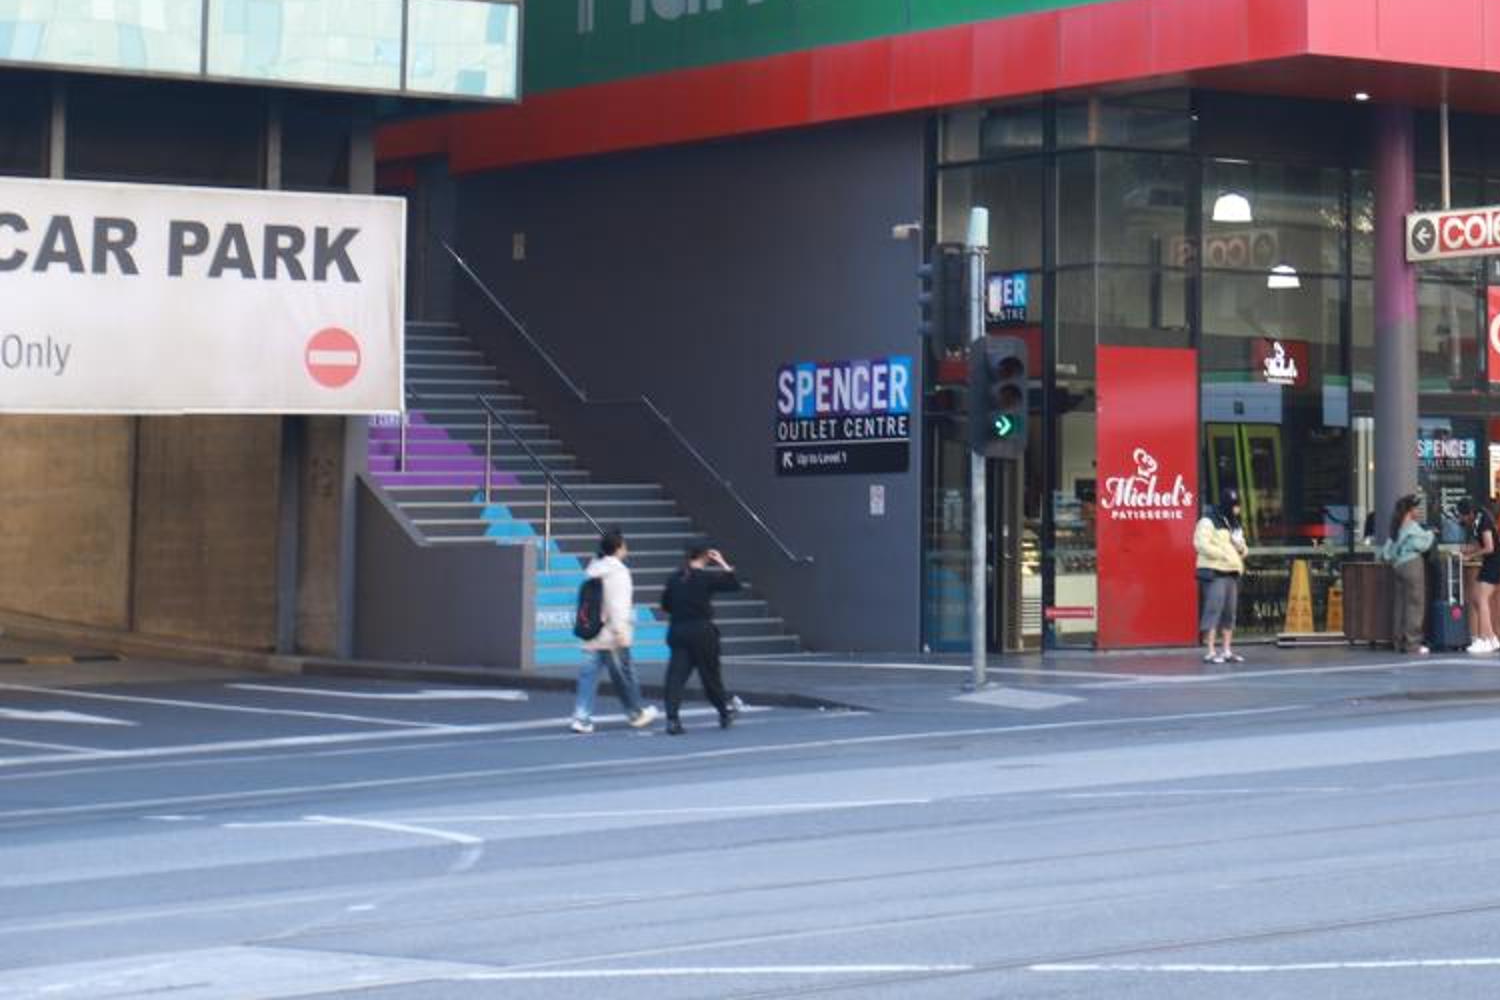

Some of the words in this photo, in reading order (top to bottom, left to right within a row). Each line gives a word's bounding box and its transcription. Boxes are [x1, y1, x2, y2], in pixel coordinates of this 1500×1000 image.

[0, 212, 139, 275] CAR
[167, 219, 362, 283] PARK
[1, 334, 71, 376] Only
[778, 364, 908, 414] SPENCER
[778, 420, 837, 440] OUTLET
[843, 416, 907, 438] CENTRE
[1417, 440, 1475, 456] SPENCER
[1102, 474, 1192, 508] Michel's
[1111, 510, 1183, 519] PATISSERIE
